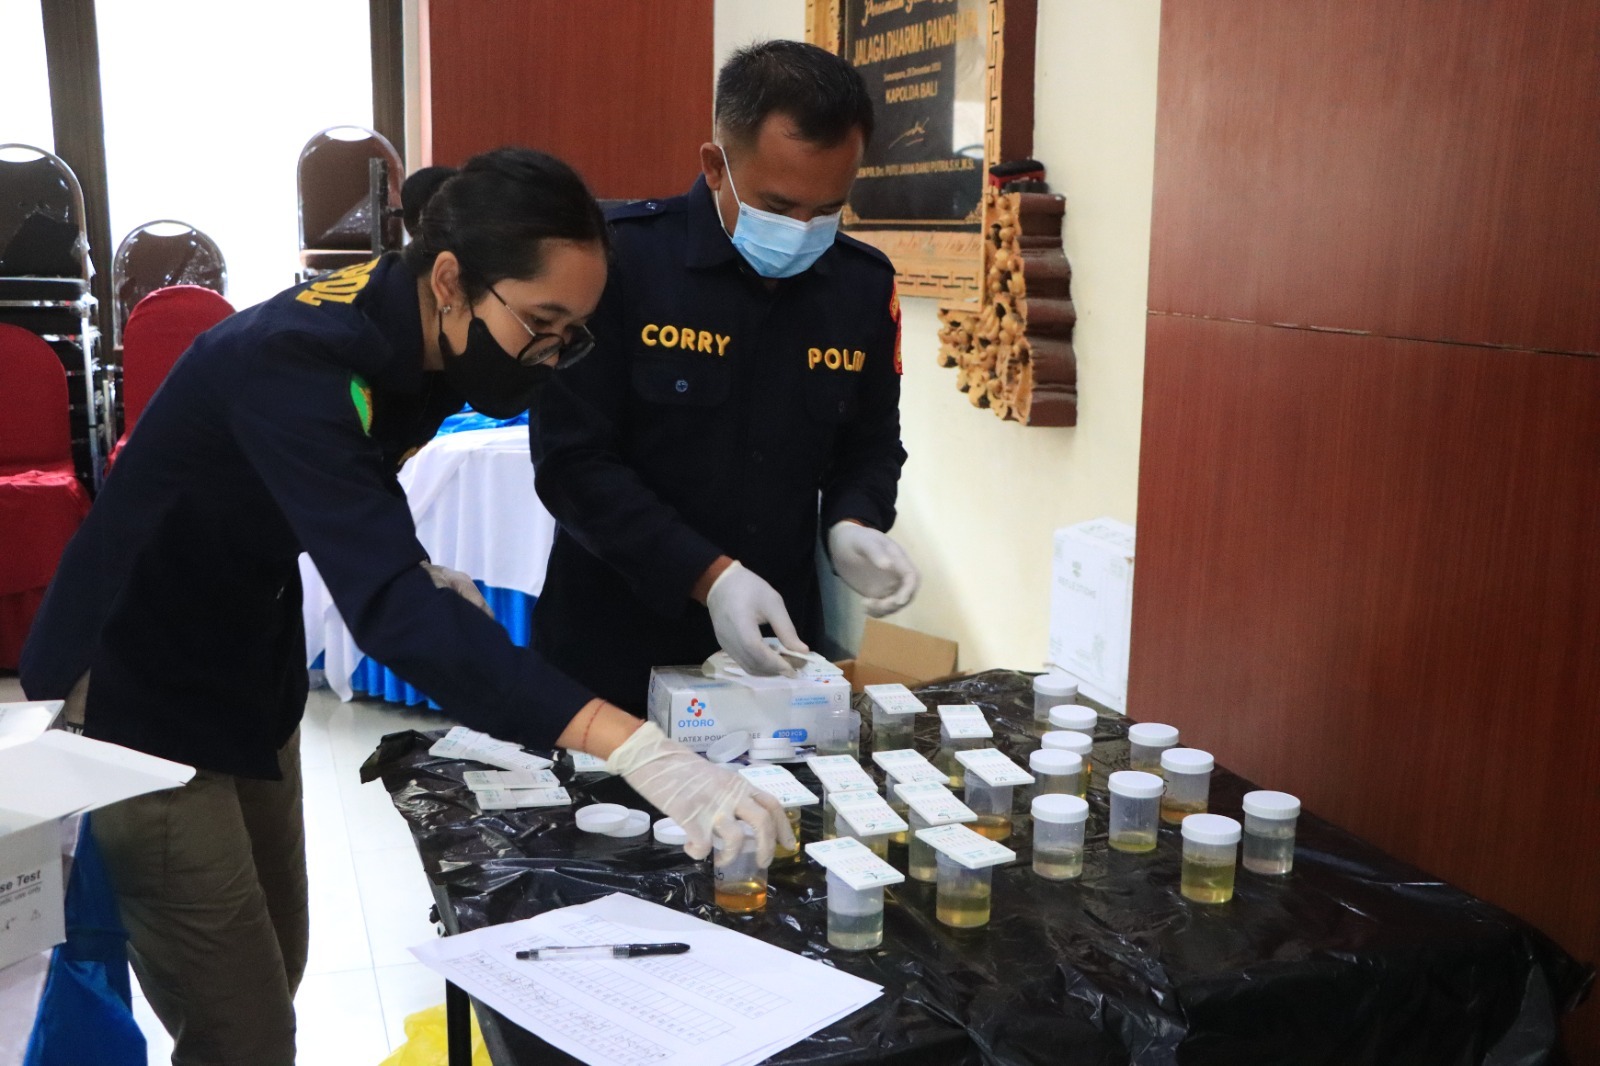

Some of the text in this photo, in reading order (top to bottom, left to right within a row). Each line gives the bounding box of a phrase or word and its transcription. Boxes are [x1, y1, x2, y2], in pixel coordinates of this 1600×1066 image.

[887, 23, 924, 59] DHARMA
[885, 80, 938, 104] KAPOLDA BALI
[641, 324, 731, 356] CORRY
[678, 719, 715, 728] OTORO
[678, 735, 702, 743] LATEX
[704, 734, 728, 742] POW
[17, 870, 40, 886] Test
